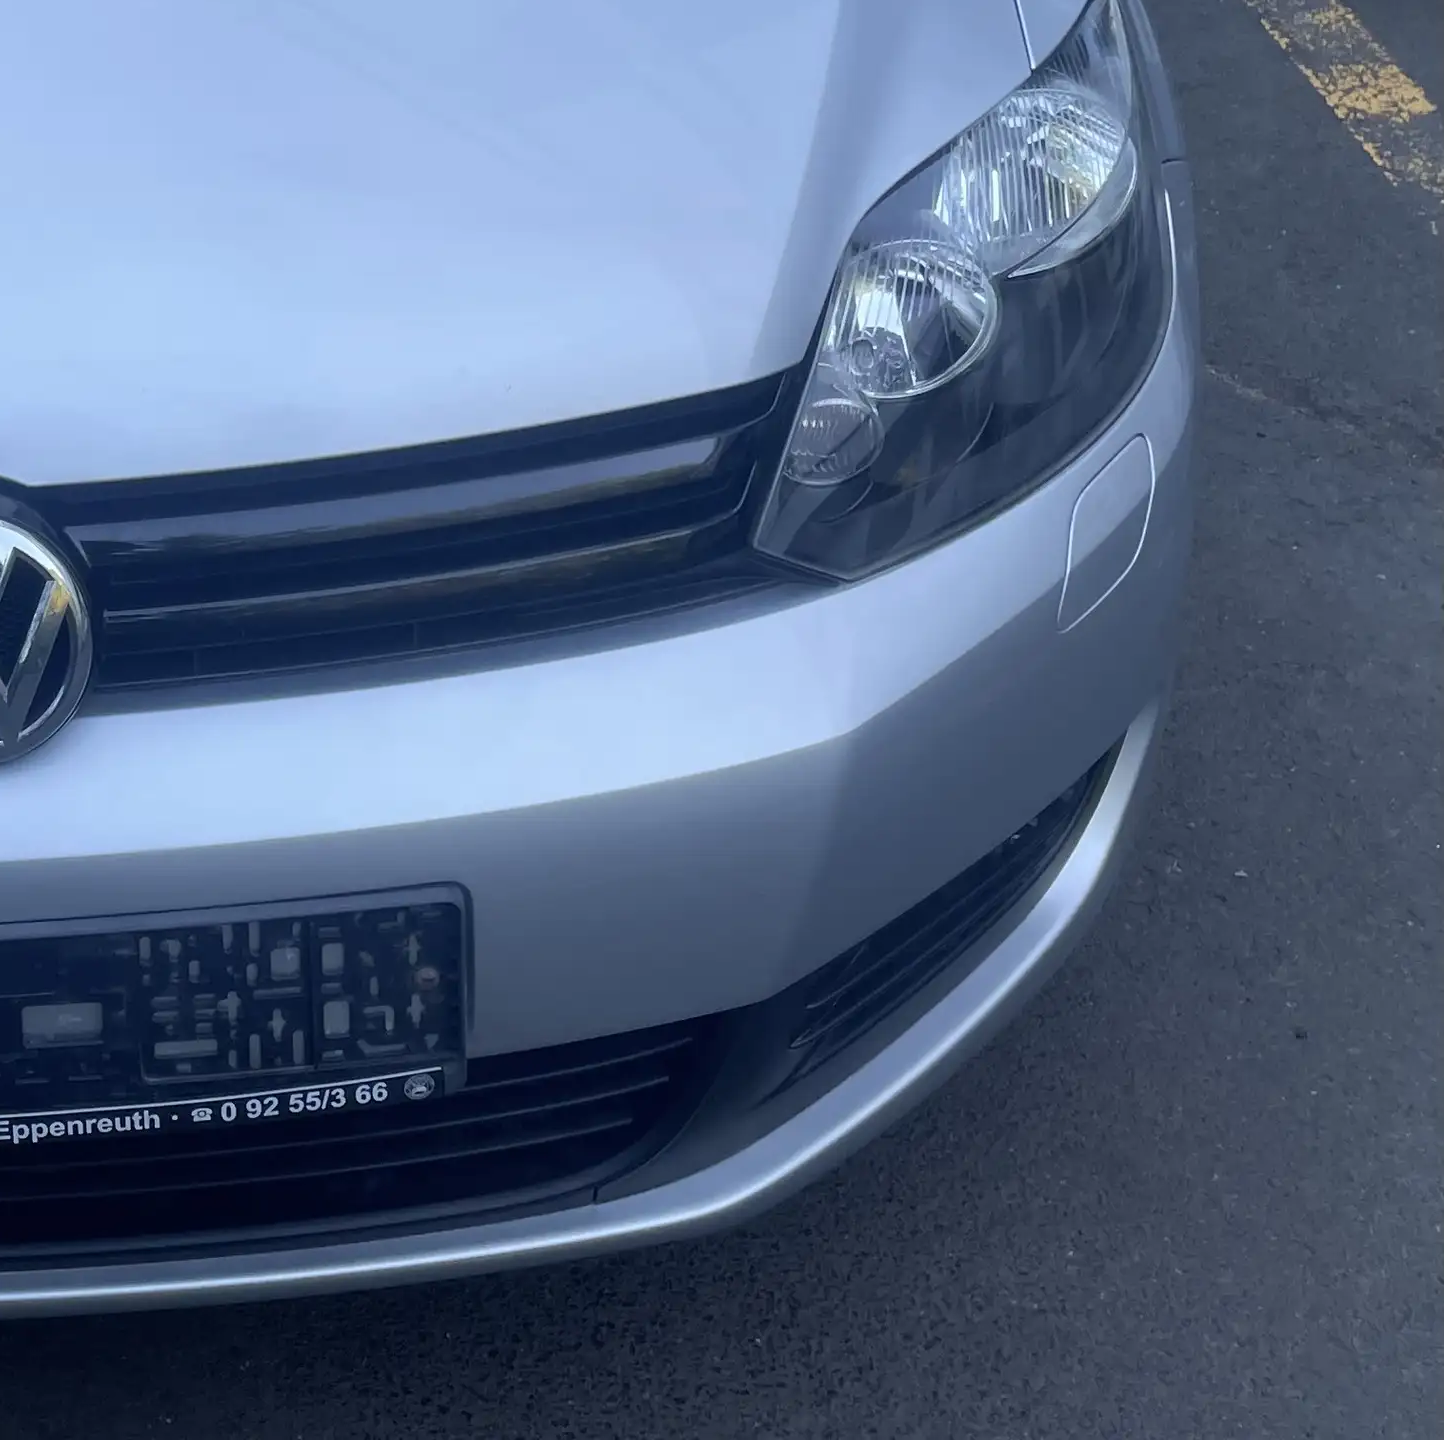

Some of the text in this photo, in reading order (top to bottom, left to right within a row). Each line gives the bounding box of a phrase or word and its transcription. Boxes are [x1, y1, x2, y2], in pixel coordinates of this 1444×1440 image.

[220, 1101, 237, 1122] 0
[245, 1096, 280, 1119] 92
[288, 1087, 347, 1113] 55/3
[355, 1081, 388, 1104] 66
